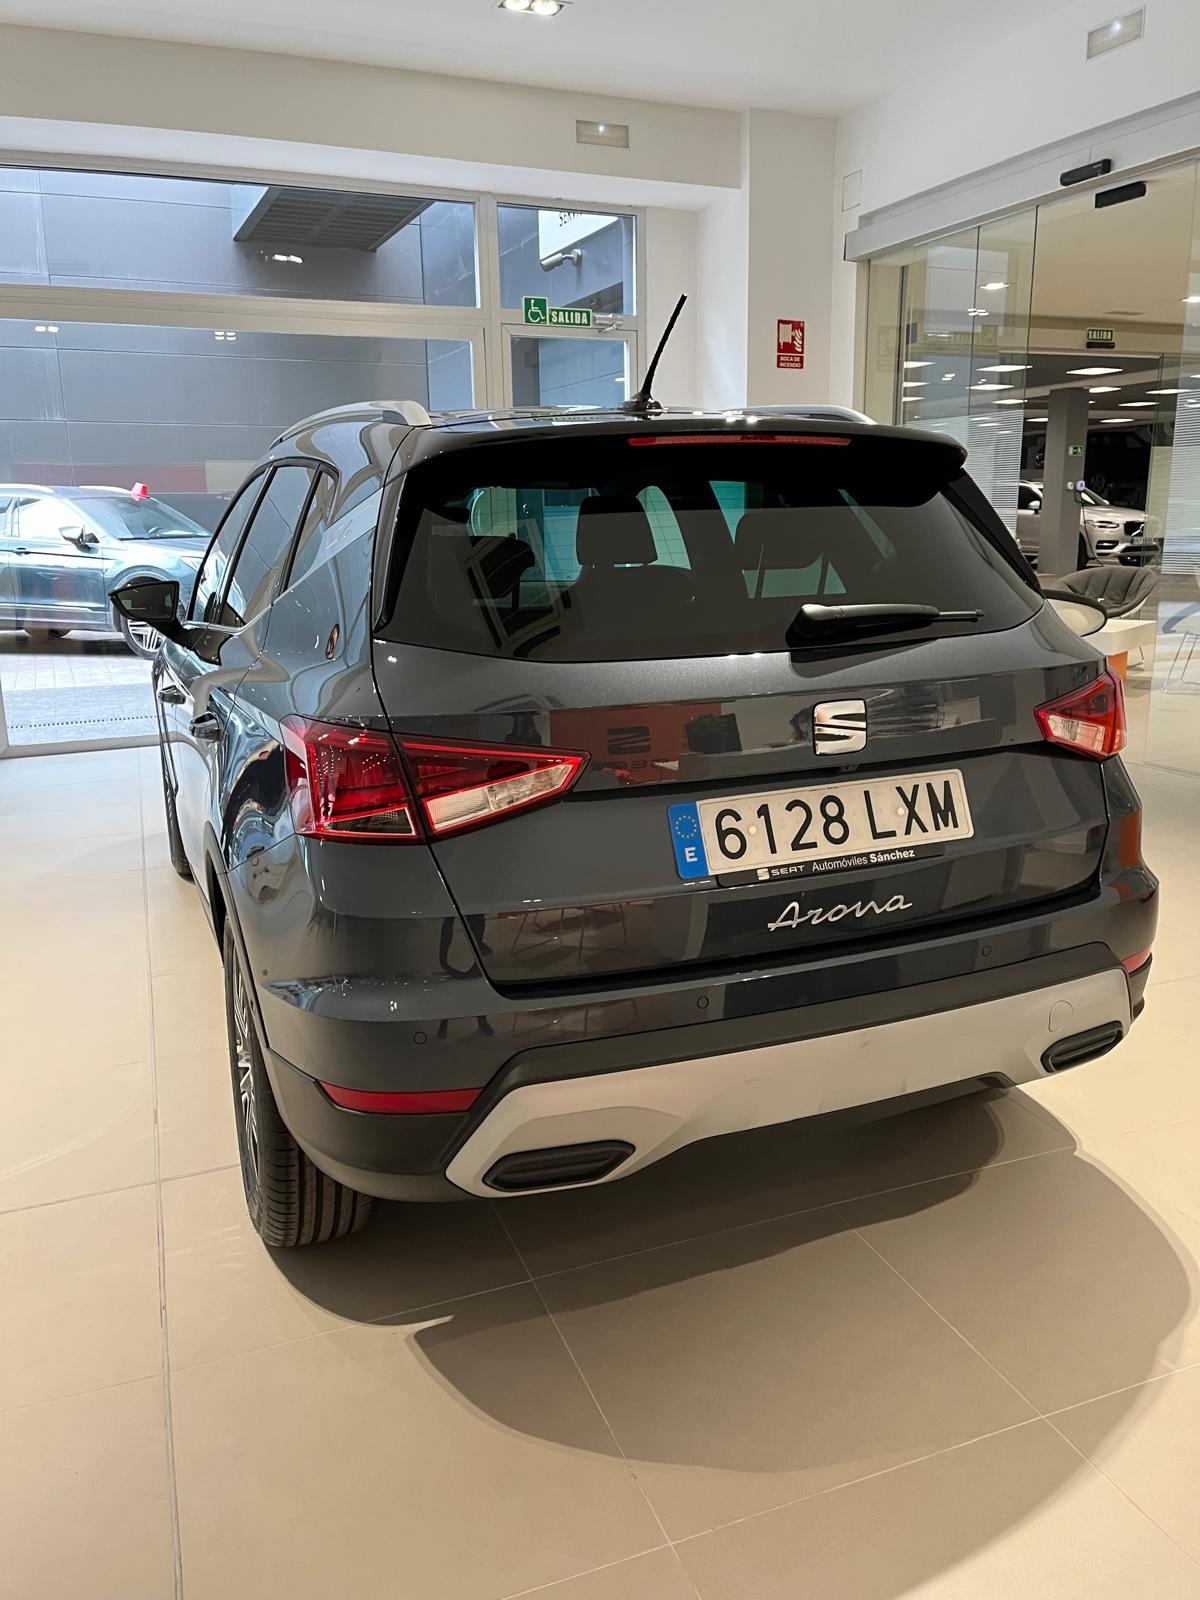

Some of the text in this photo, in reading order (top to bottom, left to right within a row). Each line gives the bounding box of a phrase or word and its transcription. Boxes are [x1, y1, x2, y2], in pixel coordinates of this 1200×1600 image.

[551, 310, 588, 325] SALIDA
[715, 780, 960, 860] 6128 LXM
[684, 847, 698, 863] E
[771, 849, 915, 876] SEAT Automóviles Sánchez
[767, 894, 913, 932] Arona
